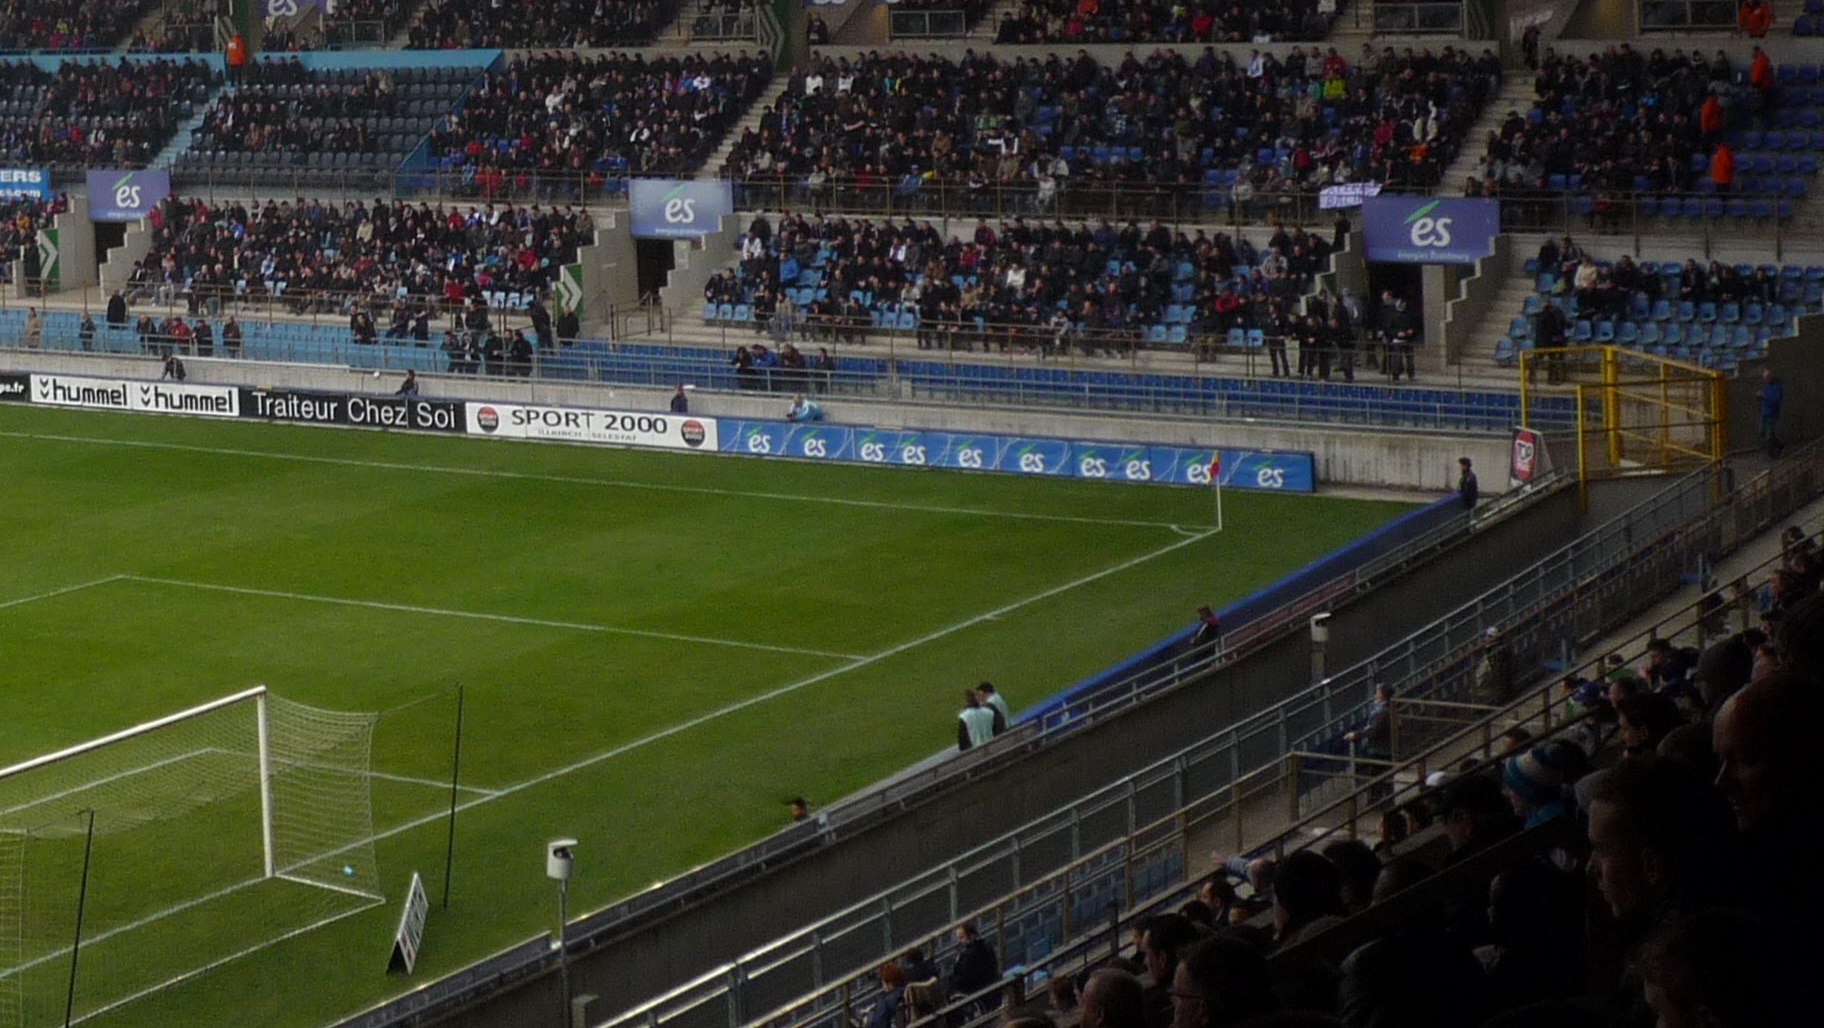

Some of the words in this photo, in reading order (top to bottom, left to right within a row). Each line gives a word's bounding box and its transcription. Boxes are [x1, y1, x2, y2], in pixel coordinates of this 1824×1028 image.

[52, 378, 128, 406] hummel
[154, 385, 234, 413] hummel
[252, 391, 338, 421] Traiteur
[348, 397, 407, 427] Chez
[416, 402, 456, 429] Soi
[511, 408, 595, 430] SPORT
[604, 414, 668, 434] 2000
